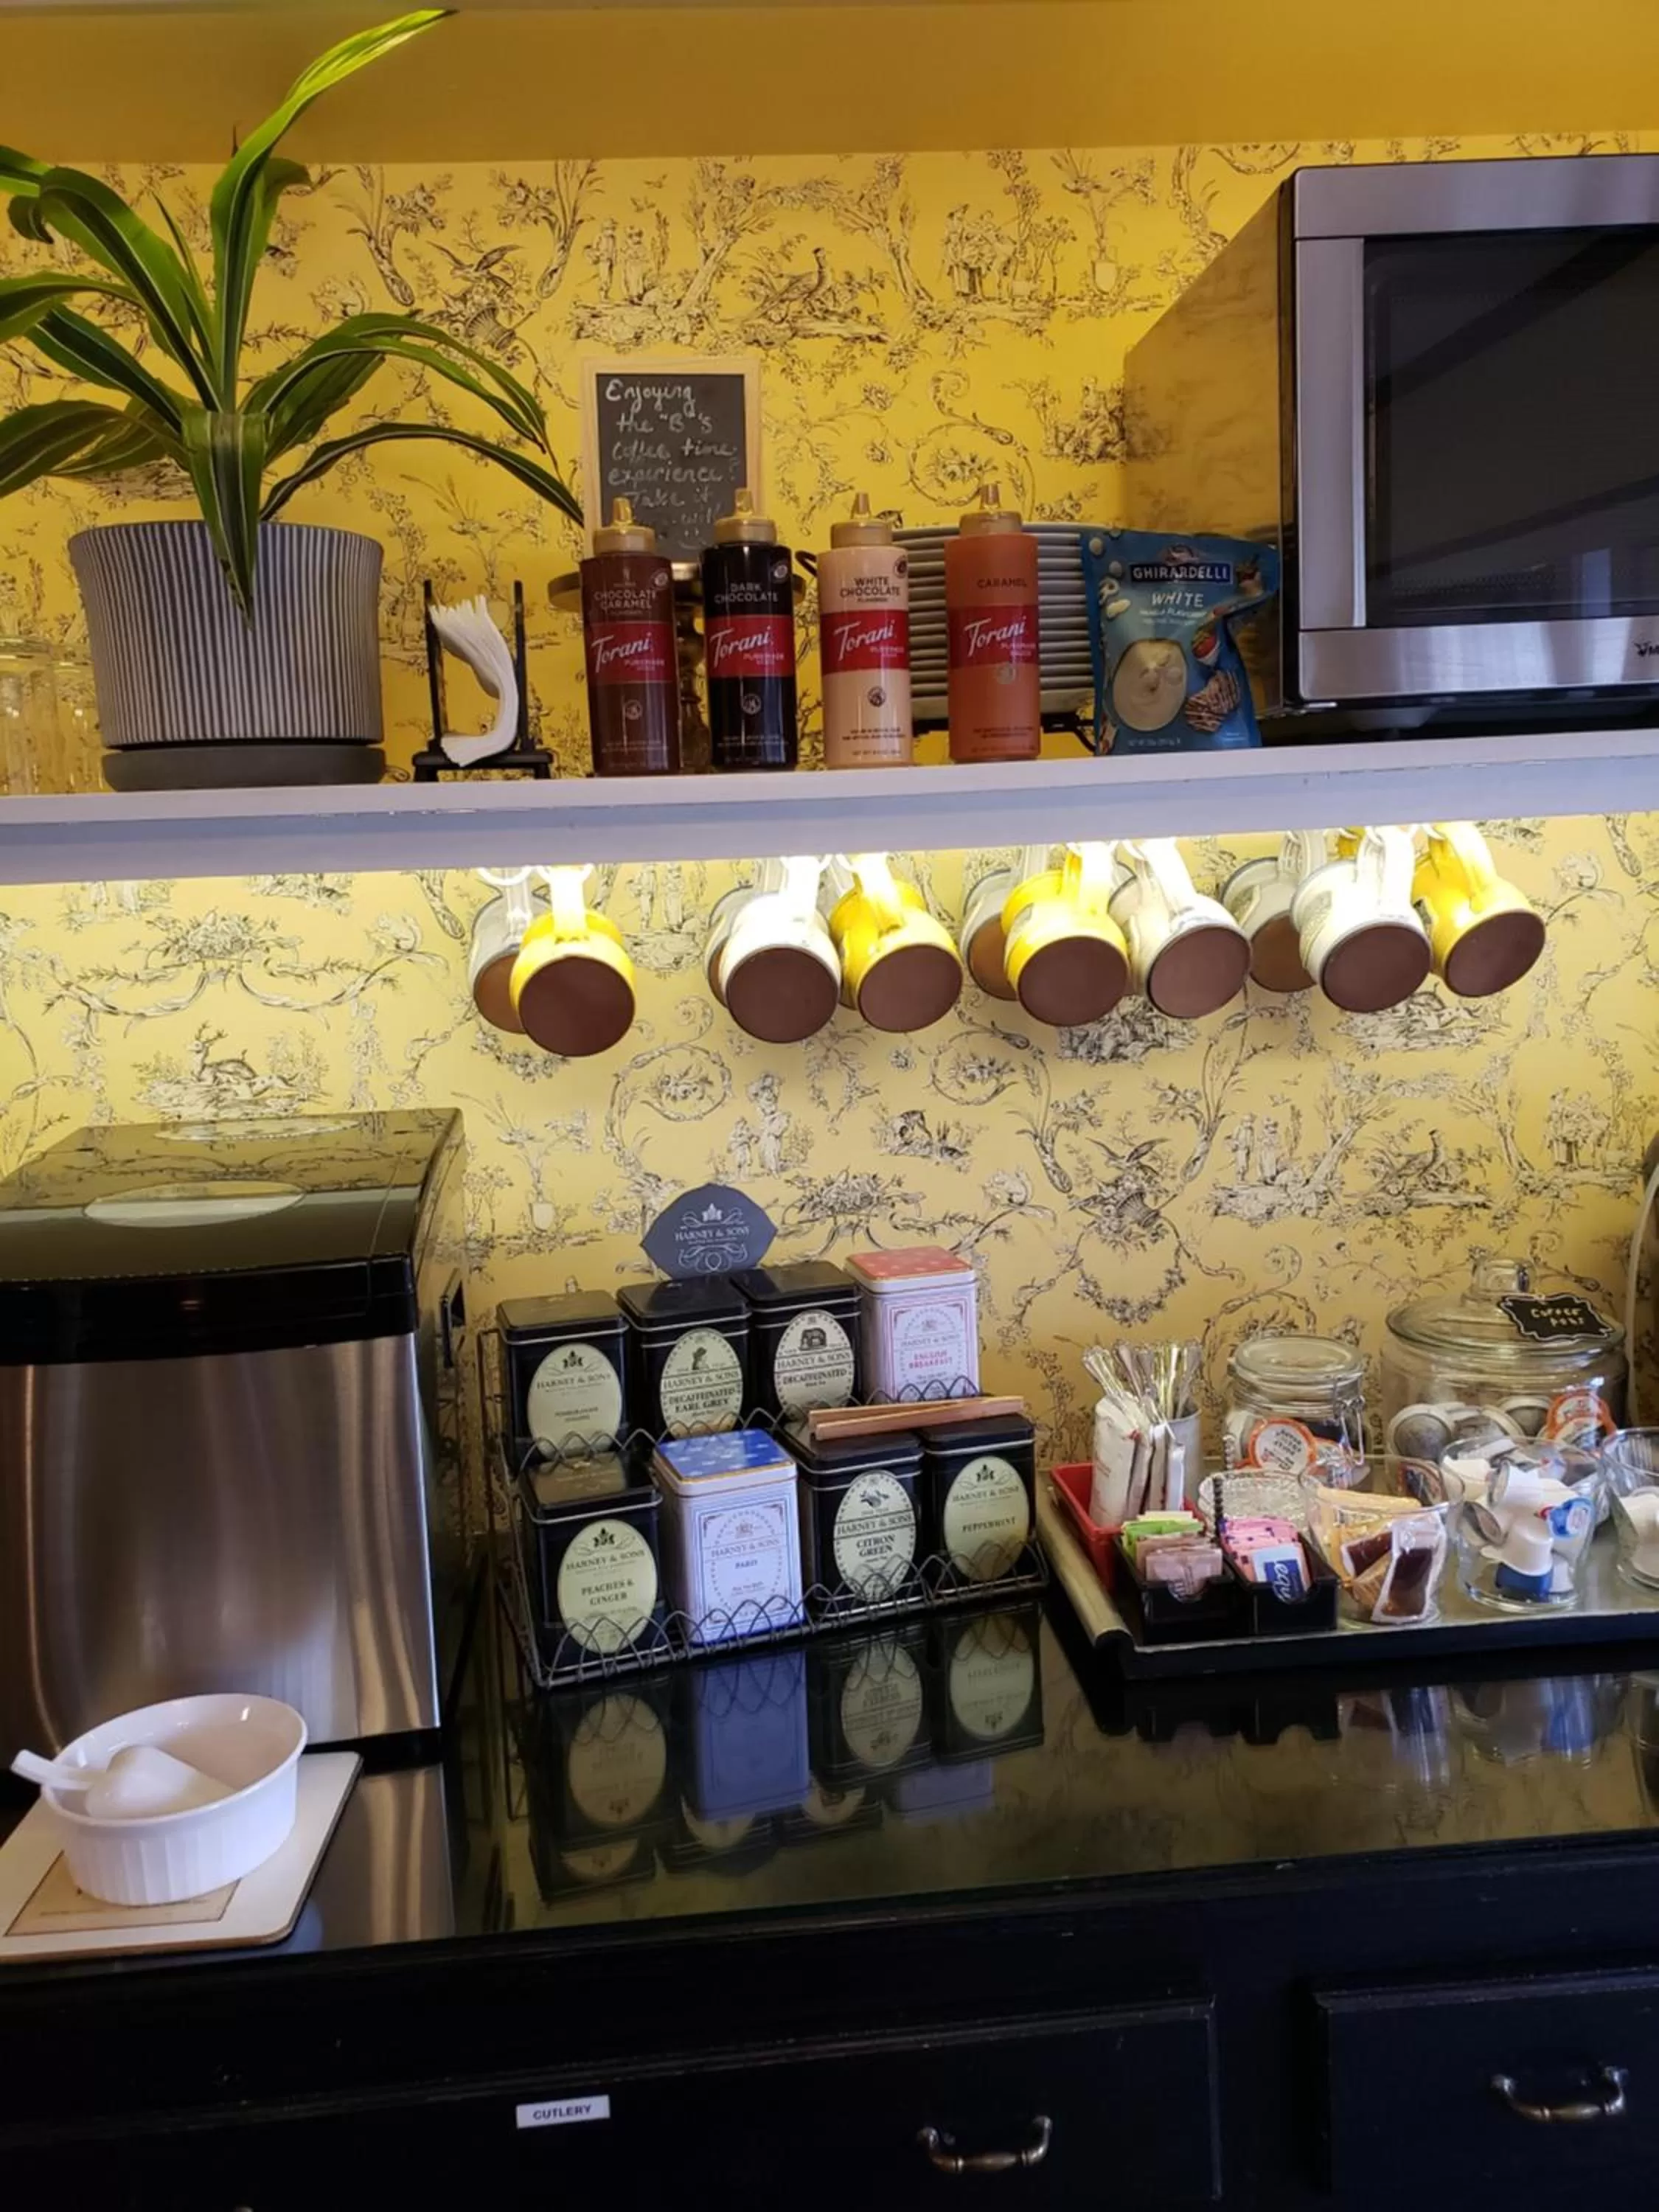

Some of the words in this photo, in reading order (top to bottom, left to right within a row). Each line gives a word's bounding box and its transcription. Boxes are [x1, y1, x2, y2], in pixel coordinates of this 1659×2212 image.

[605, 378, 695, 417] Enjoying
[616, 411, 654, 433] the
[1133, 566, 1228, 579] GHIRARDELLI
[730, 582, 762, 592] DARK
[854, 576, 888, 585] WHITE
[976, 577, 1027, 588] CARAMEL
[594, 589, 657, 601] CHOCOLATE
[714, 591, 779, 605] CHOCOLATE
[840, 586, 900, 598] CHOCOLATE
[600, 599, 652, 610] CARAMEL
[1151, 592, 1204, 608] WHITE
[833, 619, 895, 661] Torani
[964, 616, 1026, 658] Torani
[591, 632, 653, 673] Torani
[709, 625, 771, 668] Torani
[783, 1368, 847, 1384] DECAFFEINATED
[669, 1387, 735, 1405] DECAFFEINATED
[675, 1402, 699, 1413] EARL
[703, 1398, 728, 1408] GREY
[961, 1516, 1015, 1533] PEPPERMINT
[856, 1534, 895, 1548] CITRON
[859, 1545, 892, 1557] GREEN
[734, 1559, 758, 1569] PARIS
[581, 1581, 625, 1596] PEACHES
[590, 1592, 627, 1604] GINGER
[532, 2104, 592, 2121] CUTLERY
